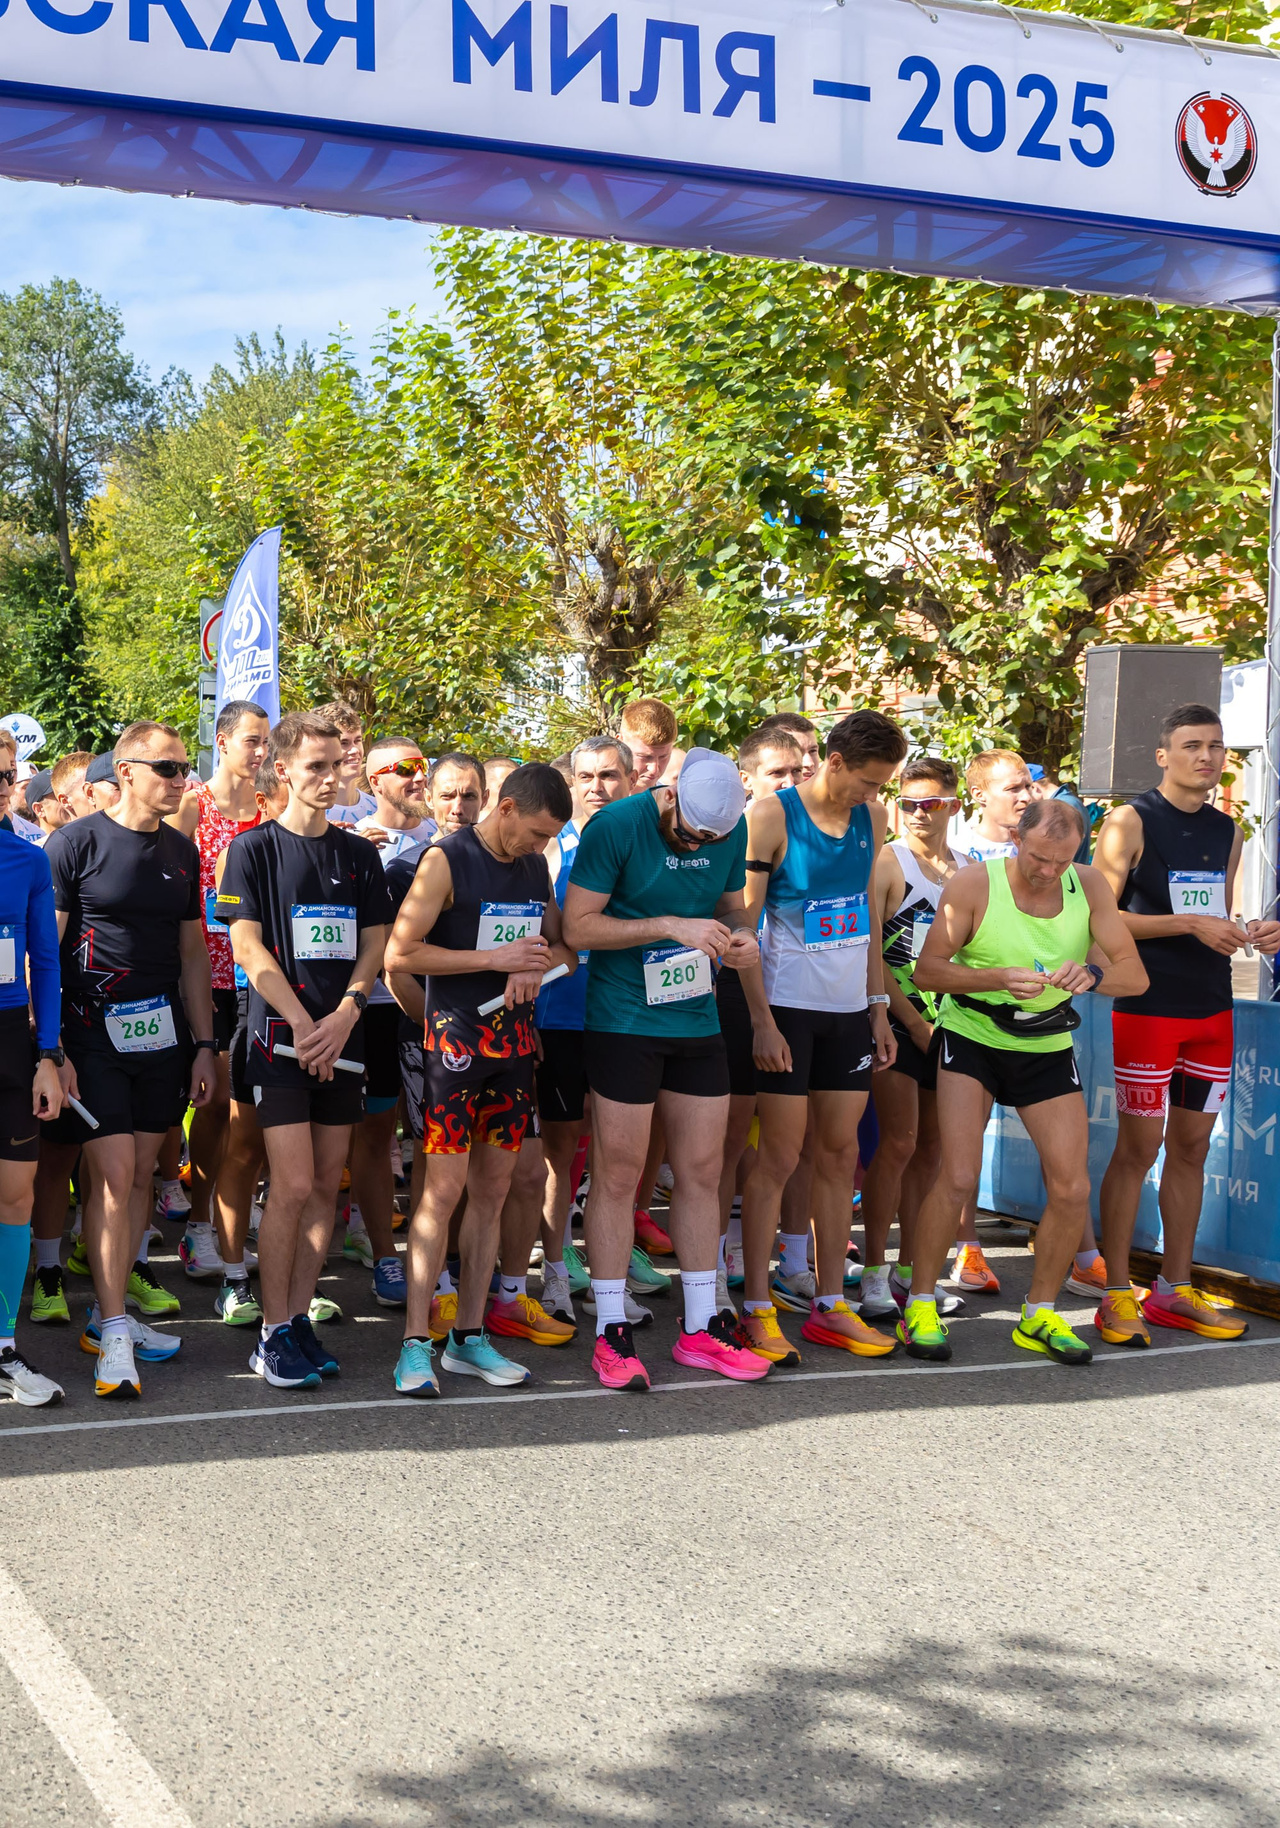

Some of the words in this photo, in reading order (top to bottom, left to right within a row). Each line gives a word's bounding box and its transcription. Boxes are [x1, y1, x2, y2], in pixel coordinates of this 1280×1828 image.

[452, 0, 776, 124] МИЛЯ
[897, 55, 1116, 168] 2025
[820, 913, 858, 937] 532
